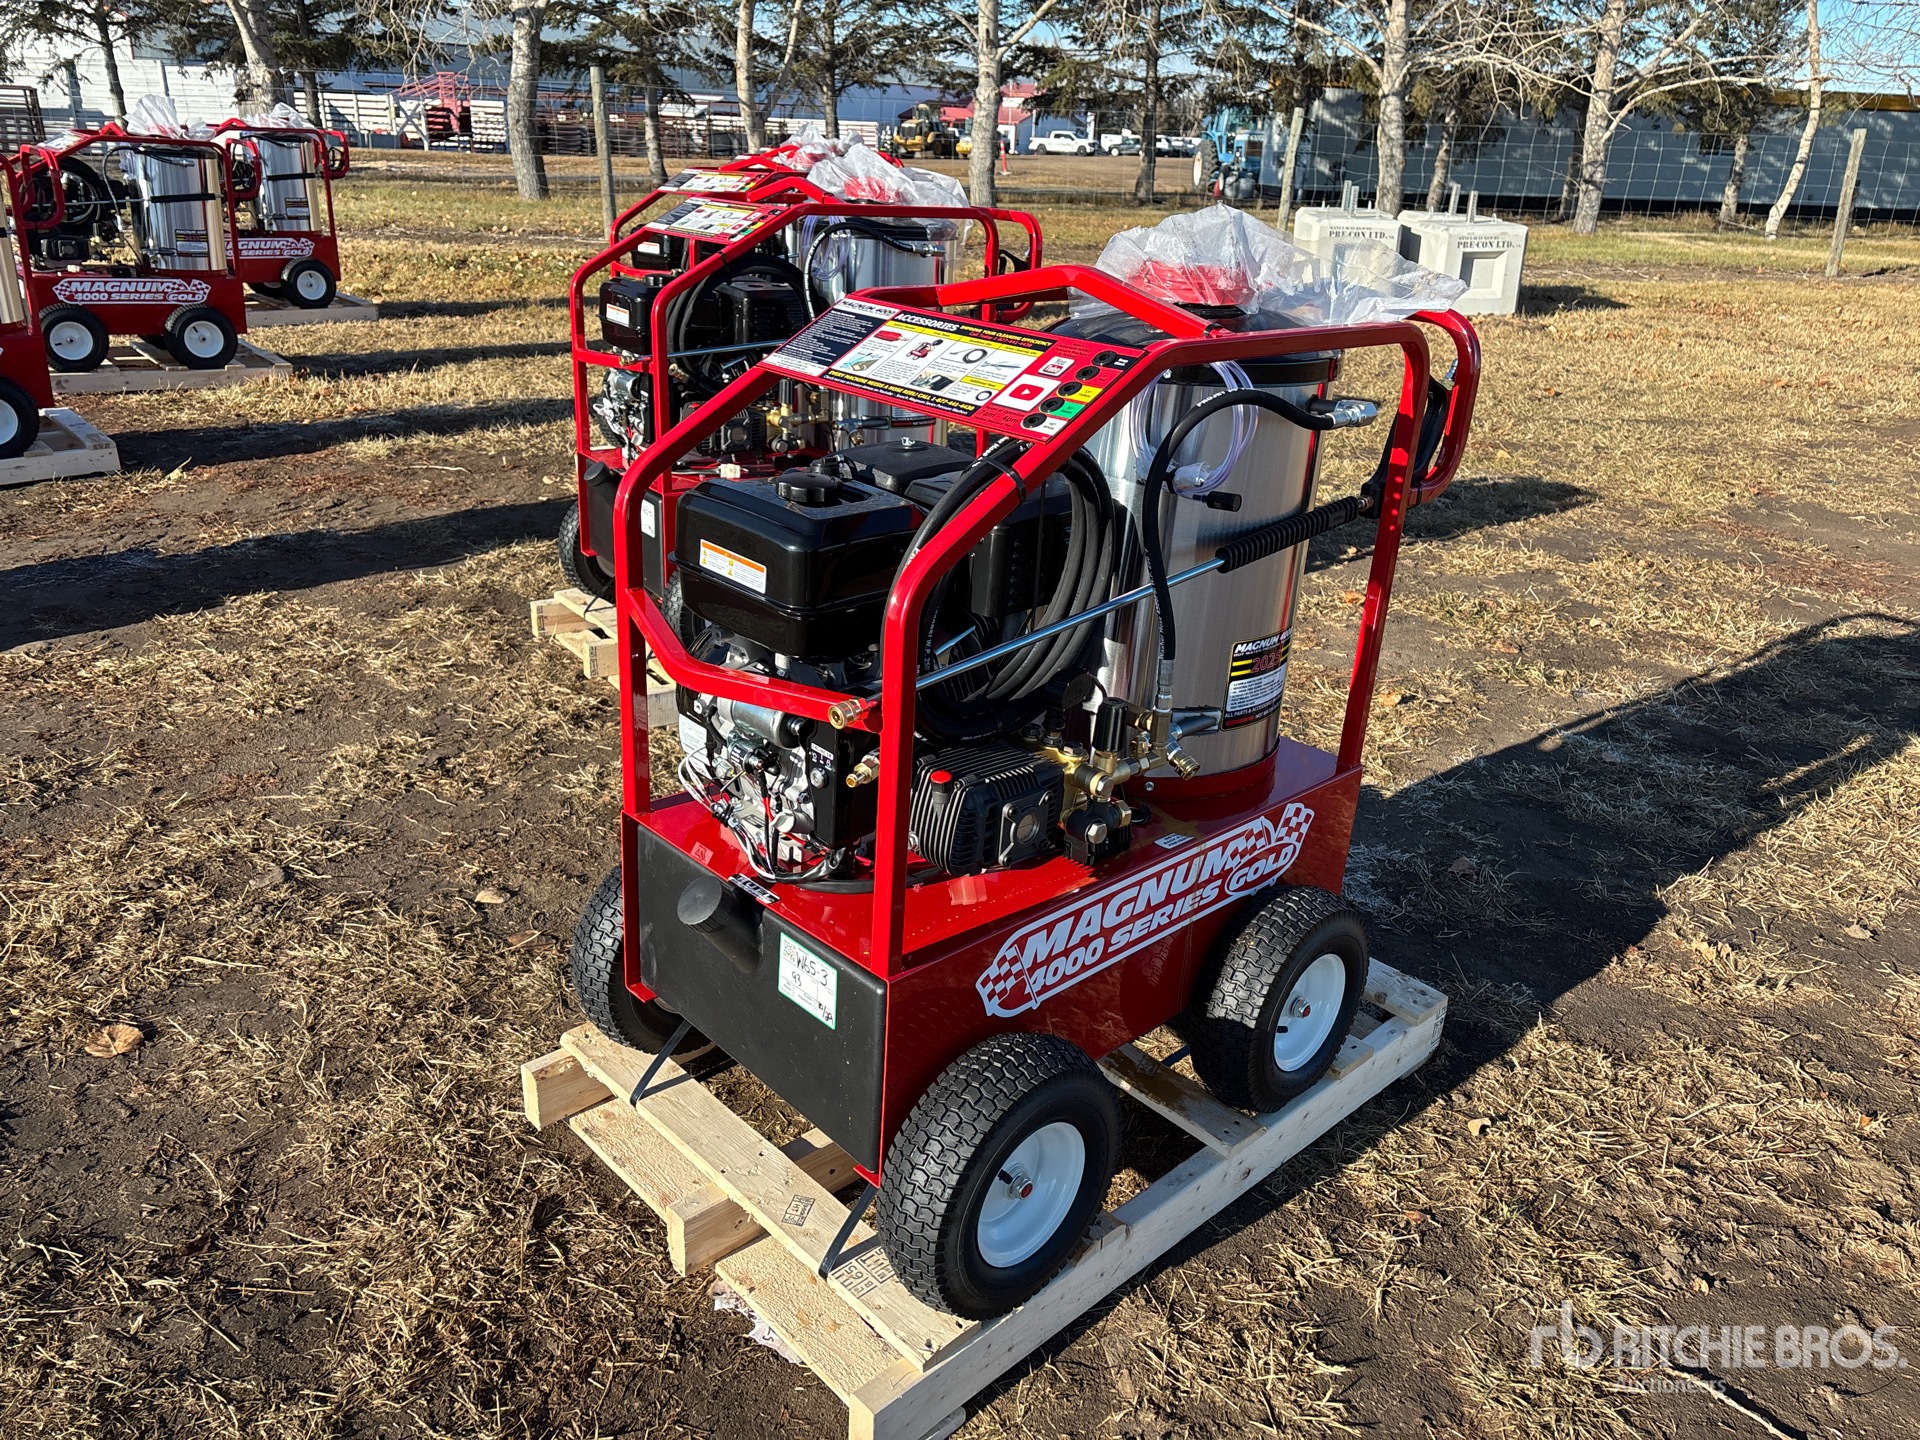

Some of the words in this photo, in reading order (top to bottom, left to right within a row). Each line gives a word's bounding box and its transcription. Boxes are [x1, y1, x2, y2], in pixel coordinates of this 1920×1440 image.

[69, 281, 171, 292] MAGNUM
[110, 292, 164, 301] SERIES
[168, 293, 203, 302] GOLD
[894, 313, 960, 332] ACCESSORIES
[978, 410, 996, 418] 7am
[1002, 415, 1019, 424] 4pm
[1235, 634, 1279, 653] MAGNUM
[1251, 649, 1283, 674] 2025
[1228, 843, 1293, 892] GOLD
[1024, 836, 1248, 968] MAGNUM
[1026, 938, 1104, 994] 4000
[1107, 879, 1222, 954] SERIES
